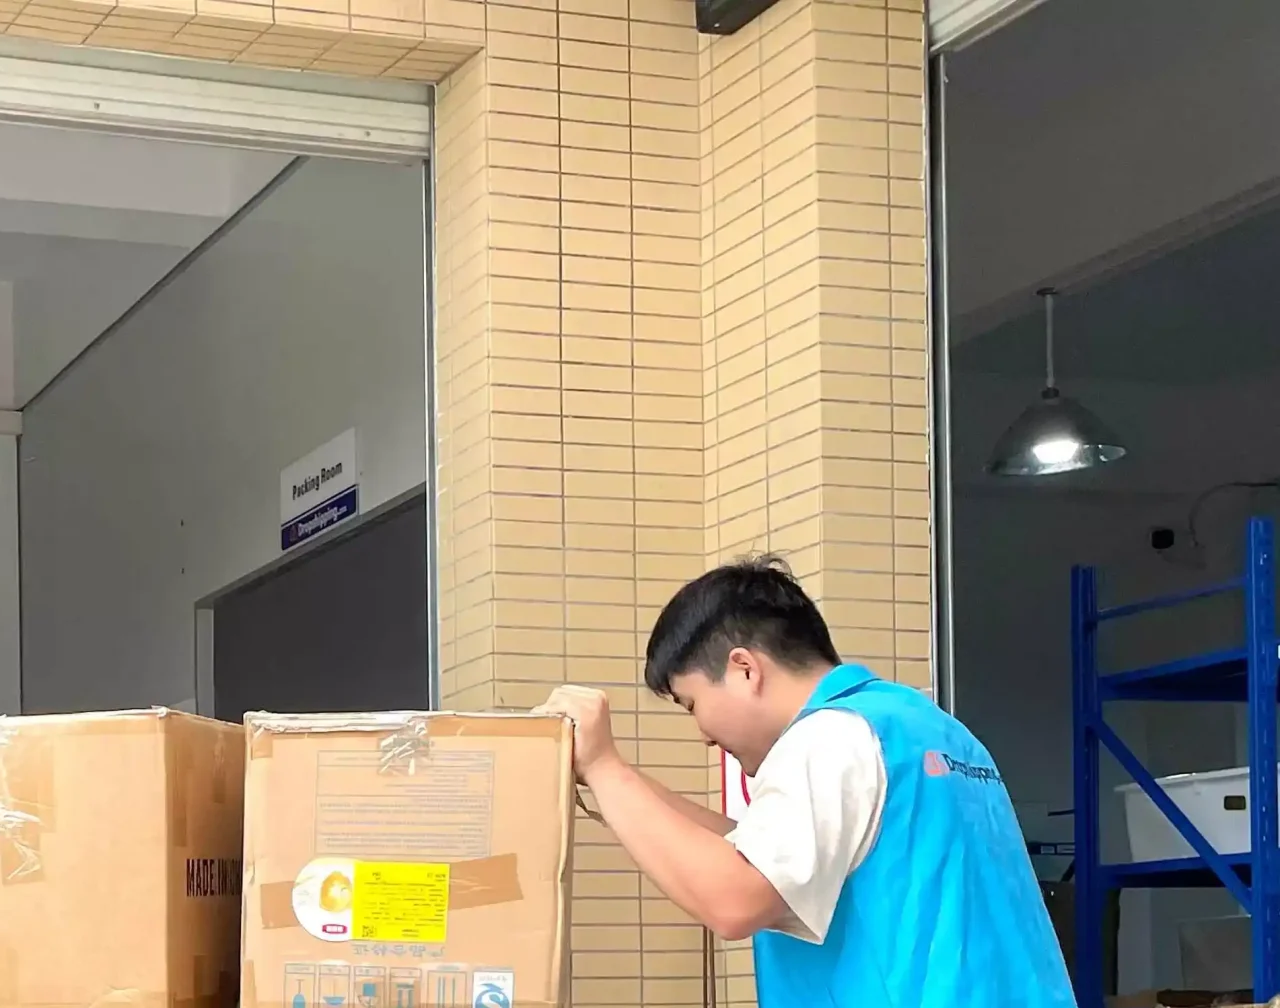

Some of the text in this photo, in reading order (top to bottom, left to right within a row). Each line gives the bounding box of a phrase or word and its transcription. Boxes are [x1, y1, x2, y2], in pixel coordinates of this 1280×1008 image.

[292, 462, 343, 500] Packing Room
[186, 858, 215, 897] MADE
